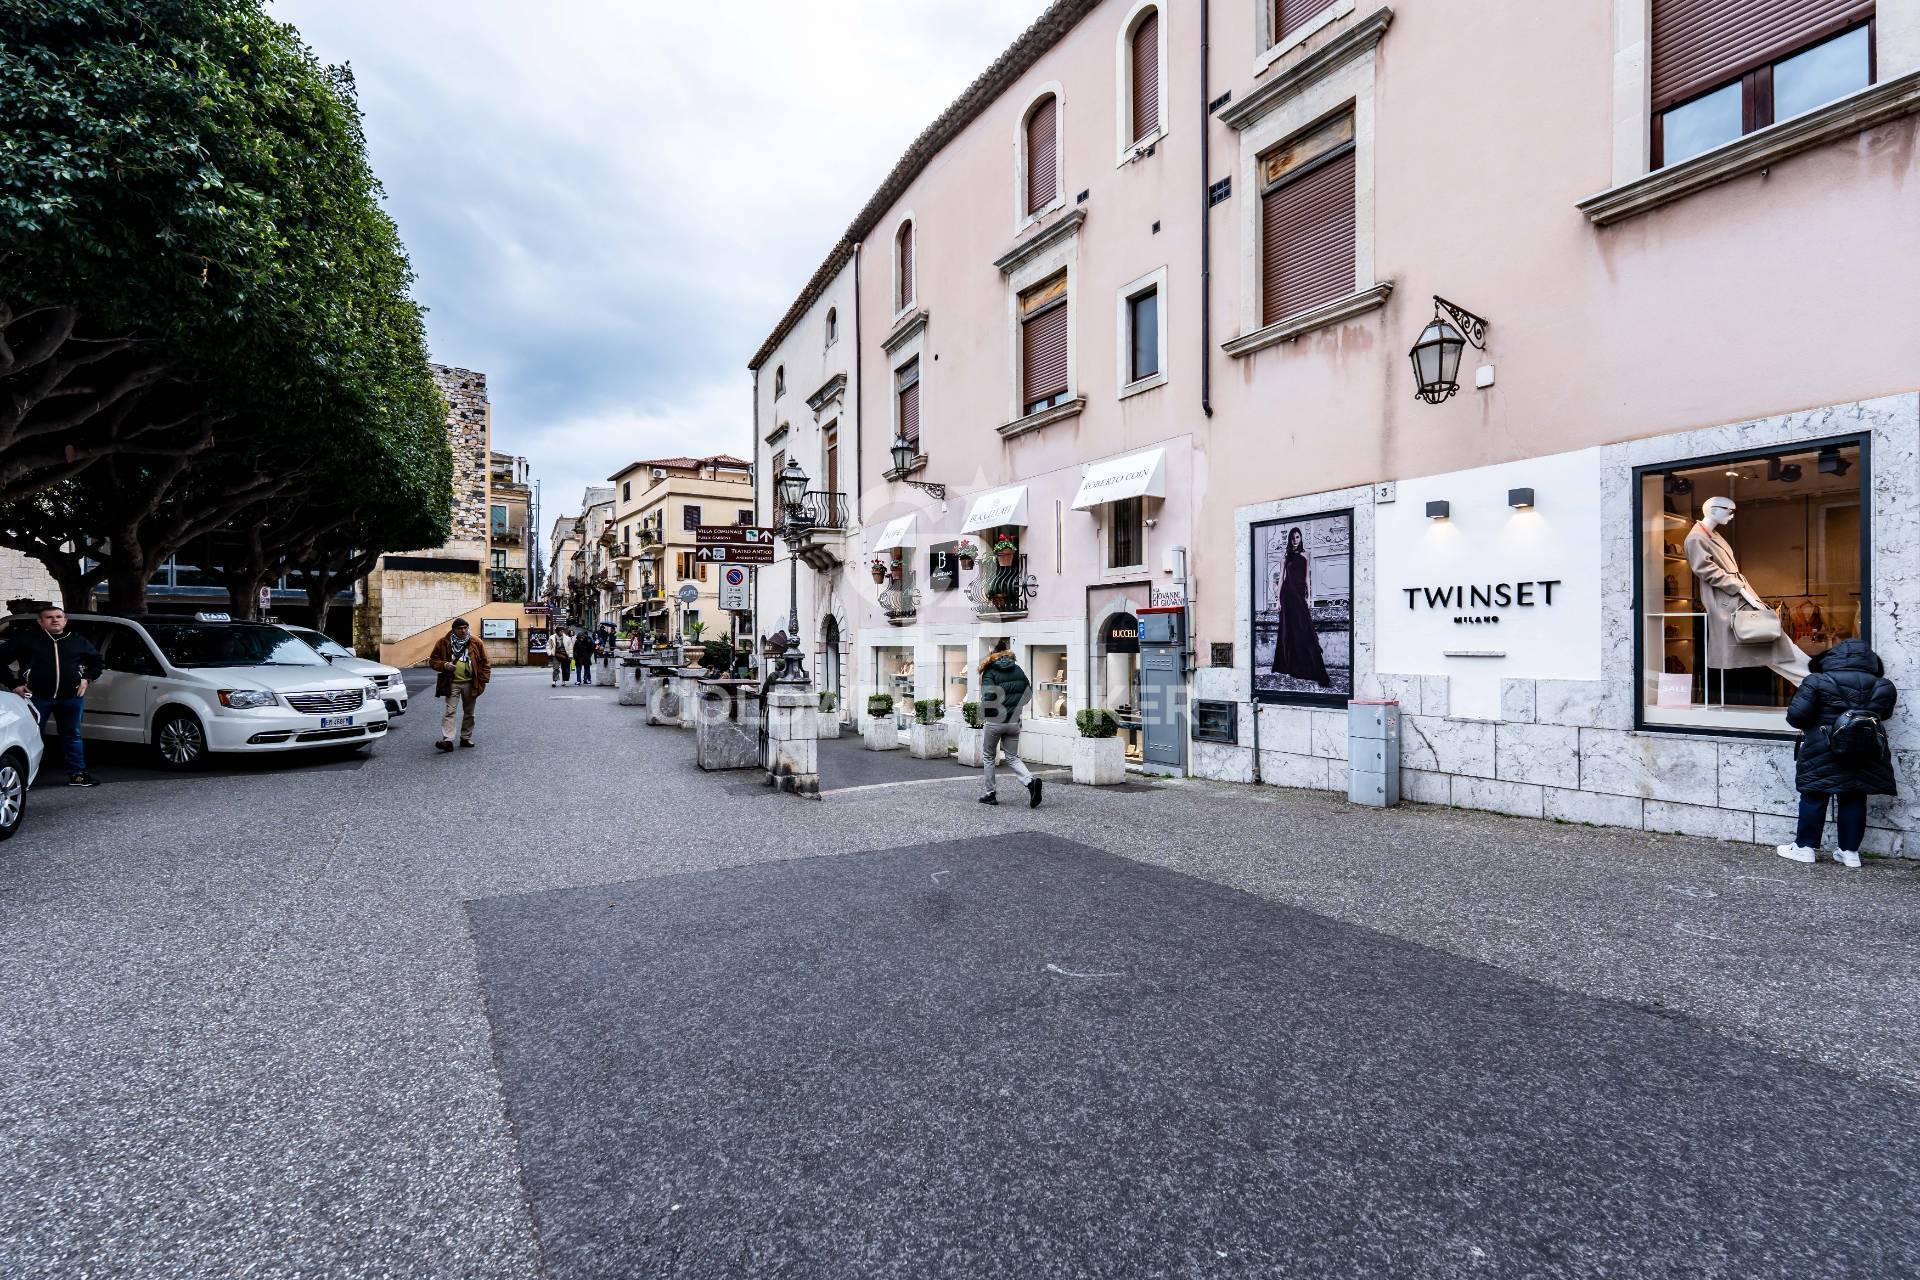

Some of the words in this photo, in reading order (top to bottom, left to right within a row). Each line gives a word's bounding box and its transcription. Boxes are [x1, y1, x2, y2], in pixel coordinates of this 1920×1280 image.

[1381, 487, 1389, 497] 3
[938, 551, 947, 569] B
[1153, 592, 1181, 600] GIOVANNI
[1402, 580, 1562, 610] TWINSET
[1153, 599, 1159, 607] DI
[1453, 615, 1500, 624] MILANO
[1662, 685, 1689, 693] SALE
